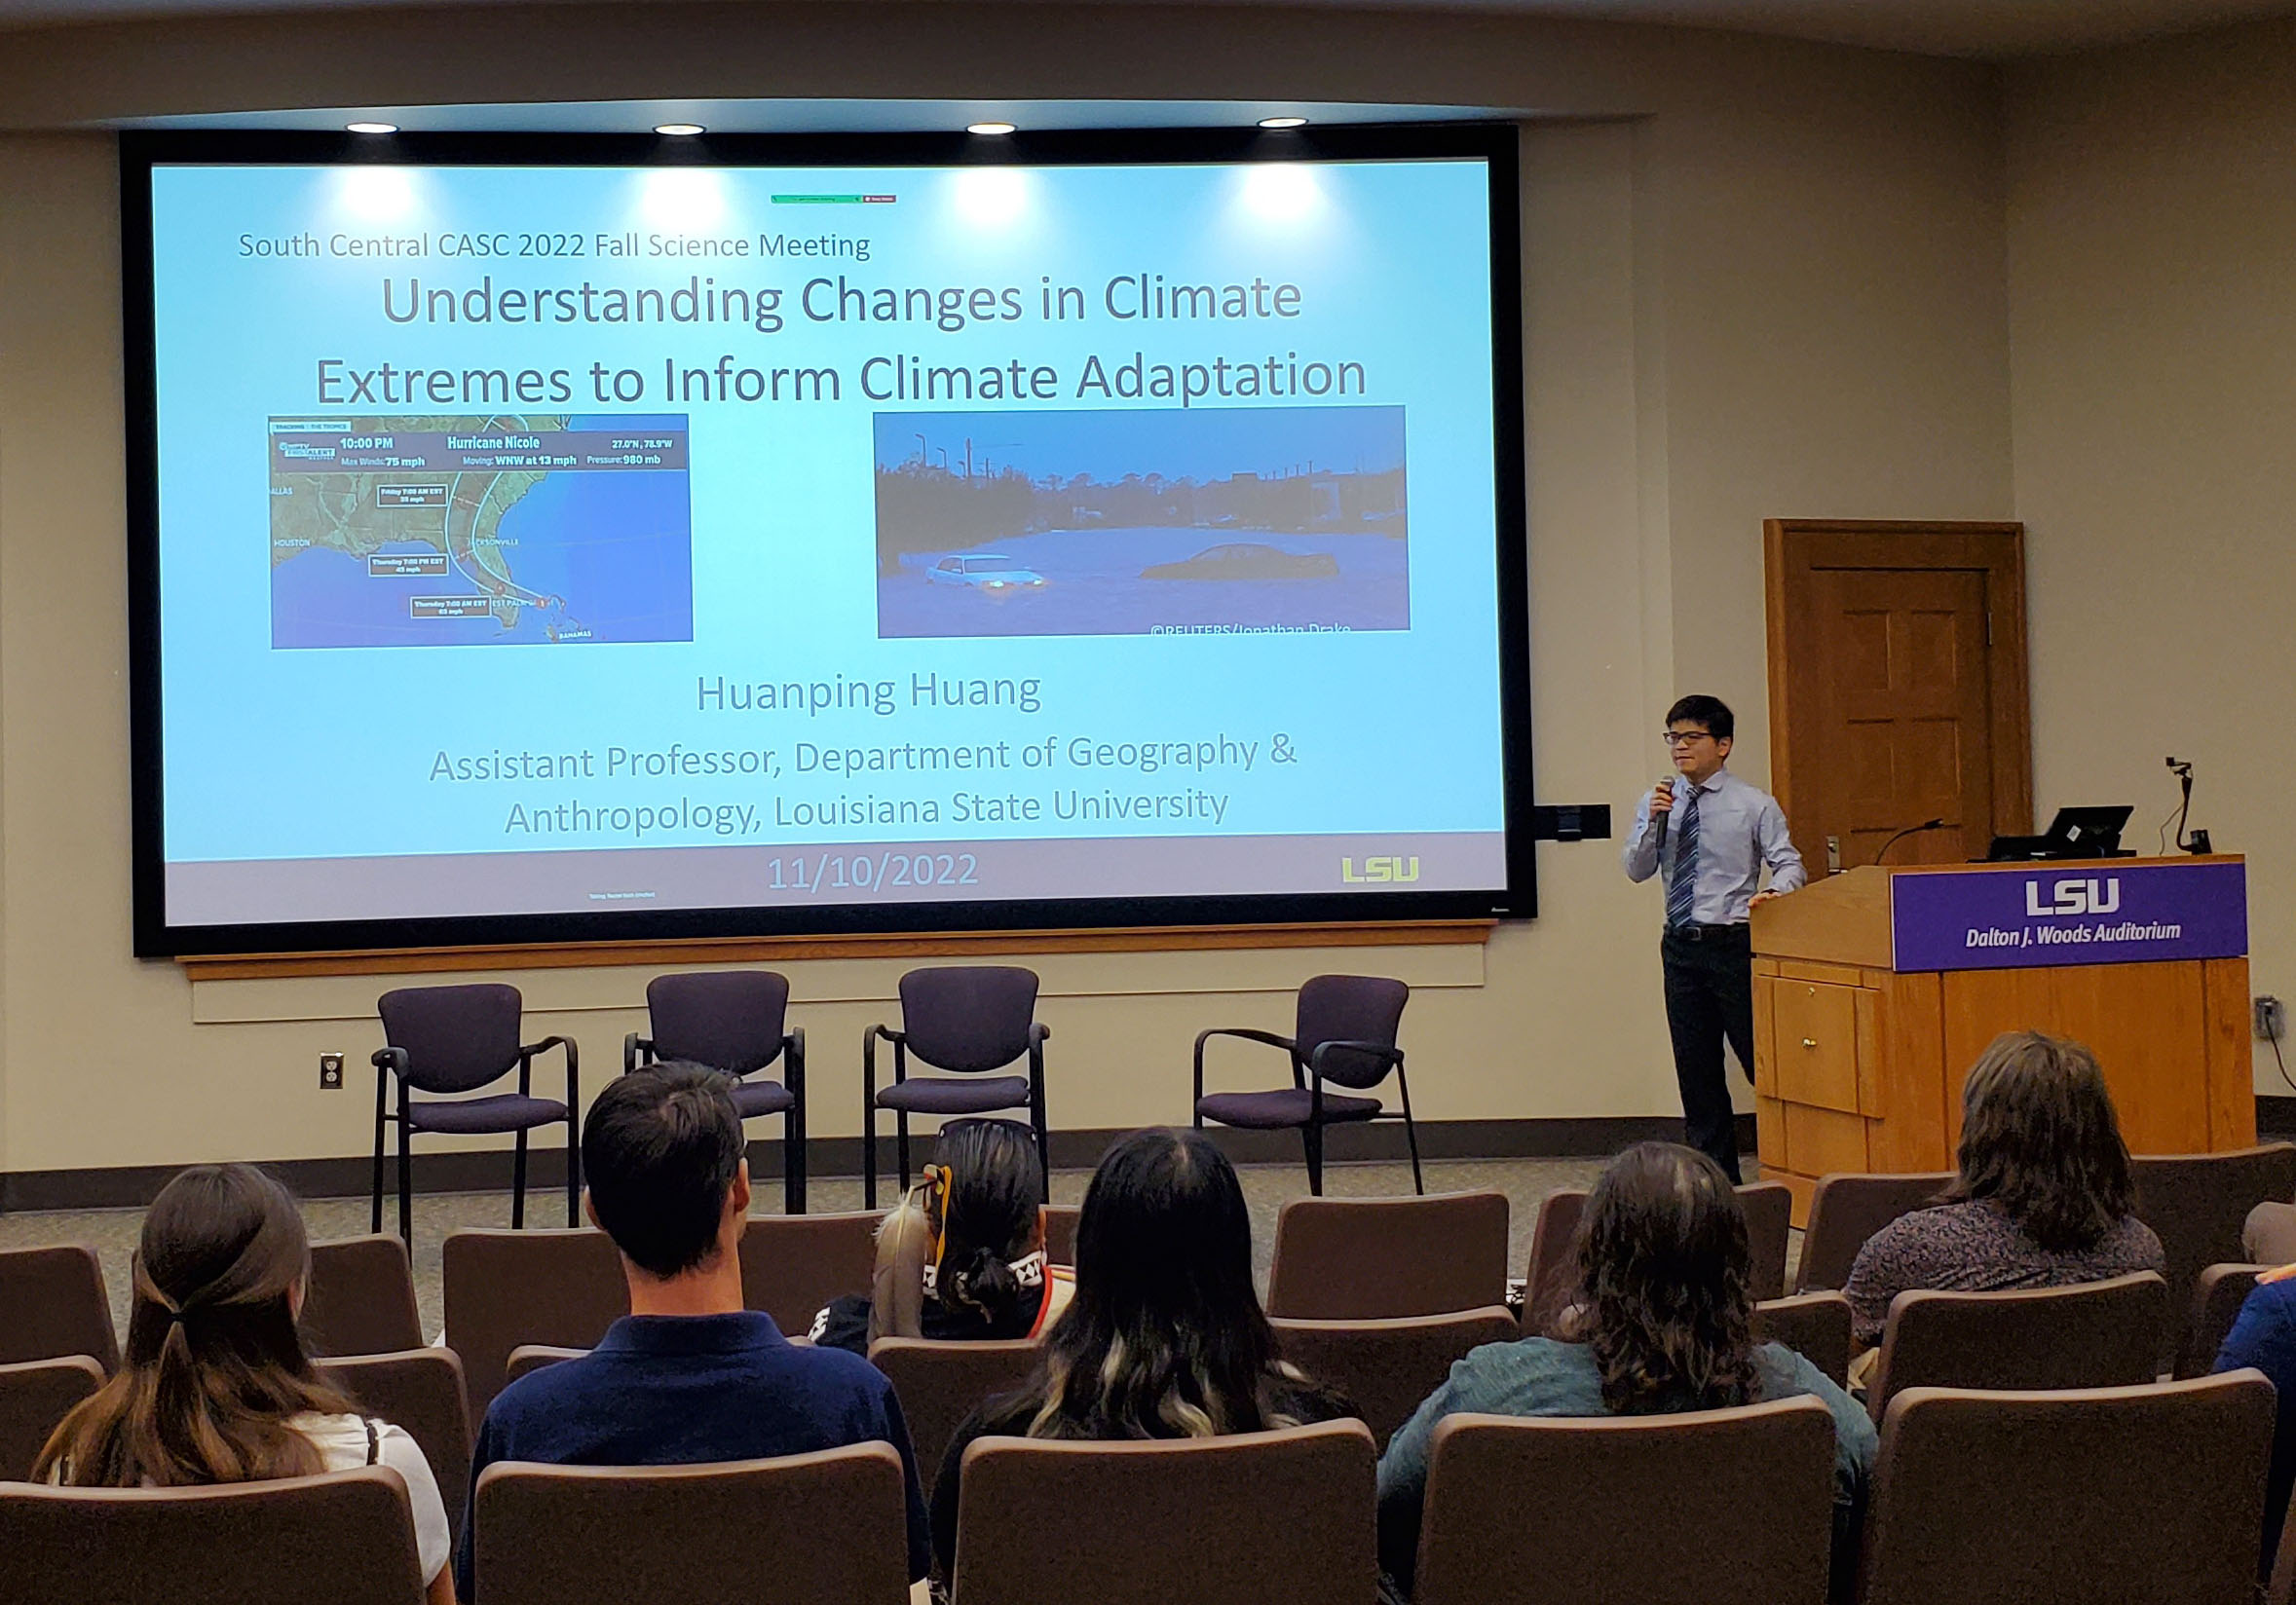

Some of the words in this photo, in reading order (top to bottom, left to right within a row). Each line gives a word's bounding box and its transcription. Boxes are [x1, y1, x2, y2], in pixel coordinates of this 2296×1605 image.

[239, 232, 321, 259] South
[329, 231, 429, 258] Central
[437, 232, 510, 258] CASC
[517, 232, 585, 258] 2022
[594, 232, 640, 258] Fall
[648, 231, 750, 258] Science
[758, 232, 871, 264] Meeting
[383, 276, 784, 333] Understanding
[801, 275, 1022, 333] Changes
[1041, 276, 1085, 320] in
[1105, 274, 1302, 319] Climate
[317, 358, 572, 405] Extremes
[587, 363, 646, 403] to
[665, 355, 841, 403] Inform
[860, 355, 1059, 401] Climate
[1075, 352, 1367, 409] Adaptation
[340, 437, 373, 449] 10:00
[374, 437, 394, 449] PM
[447, 435, 505, 450] Hurricane
[505, 435, 541, 450] Nicole
[386, 457, 399, 467] 75
[401, 457, 426, 468] mph
[463, 456, 494, 467] Moving:
[495, 456, 524, 466] WNW
[526, 456, 537, 466] at
[539, 456, 551, 466] 13
[552, 456, 577, 467] mph
[586, 455, 622, 466] Pressure:
[623, 455, 643, 465] 980
[644, 455, 660, 465] mb
[468, 538, 518, 546] JCKSONVILLE
[697, 673, 896, 716] Huanping
[911, 672, 1041, 714] Huang
[430, 749, 594, 781] Assistant
[607, 743, 781, 779] Professor,
[796, 741, 1010, 778] Department
[1022, 736, 1058, 767] of
[1068, 732, 1259, 771] Geography
[1270, 732, 1298, 764] &
[505, 797, 762, 838] Anthropology,
[775, 794, 940, 827] Louisiana
[952, 792, 1040, 823] State
[1054, 788, 1229, 825] University
[768, 851, 979, 894] 11/10/2022
[1341, 856, 1419, 883] LSU
[2025, 877, 2120, 916] LSU
[1966, 926, 2019, 948] Dalton
[2020, 926, 2033, 949] J.
[2037, 924, 2091, 946] Woods
[2093, 921, 2181, 943] Auditorium
